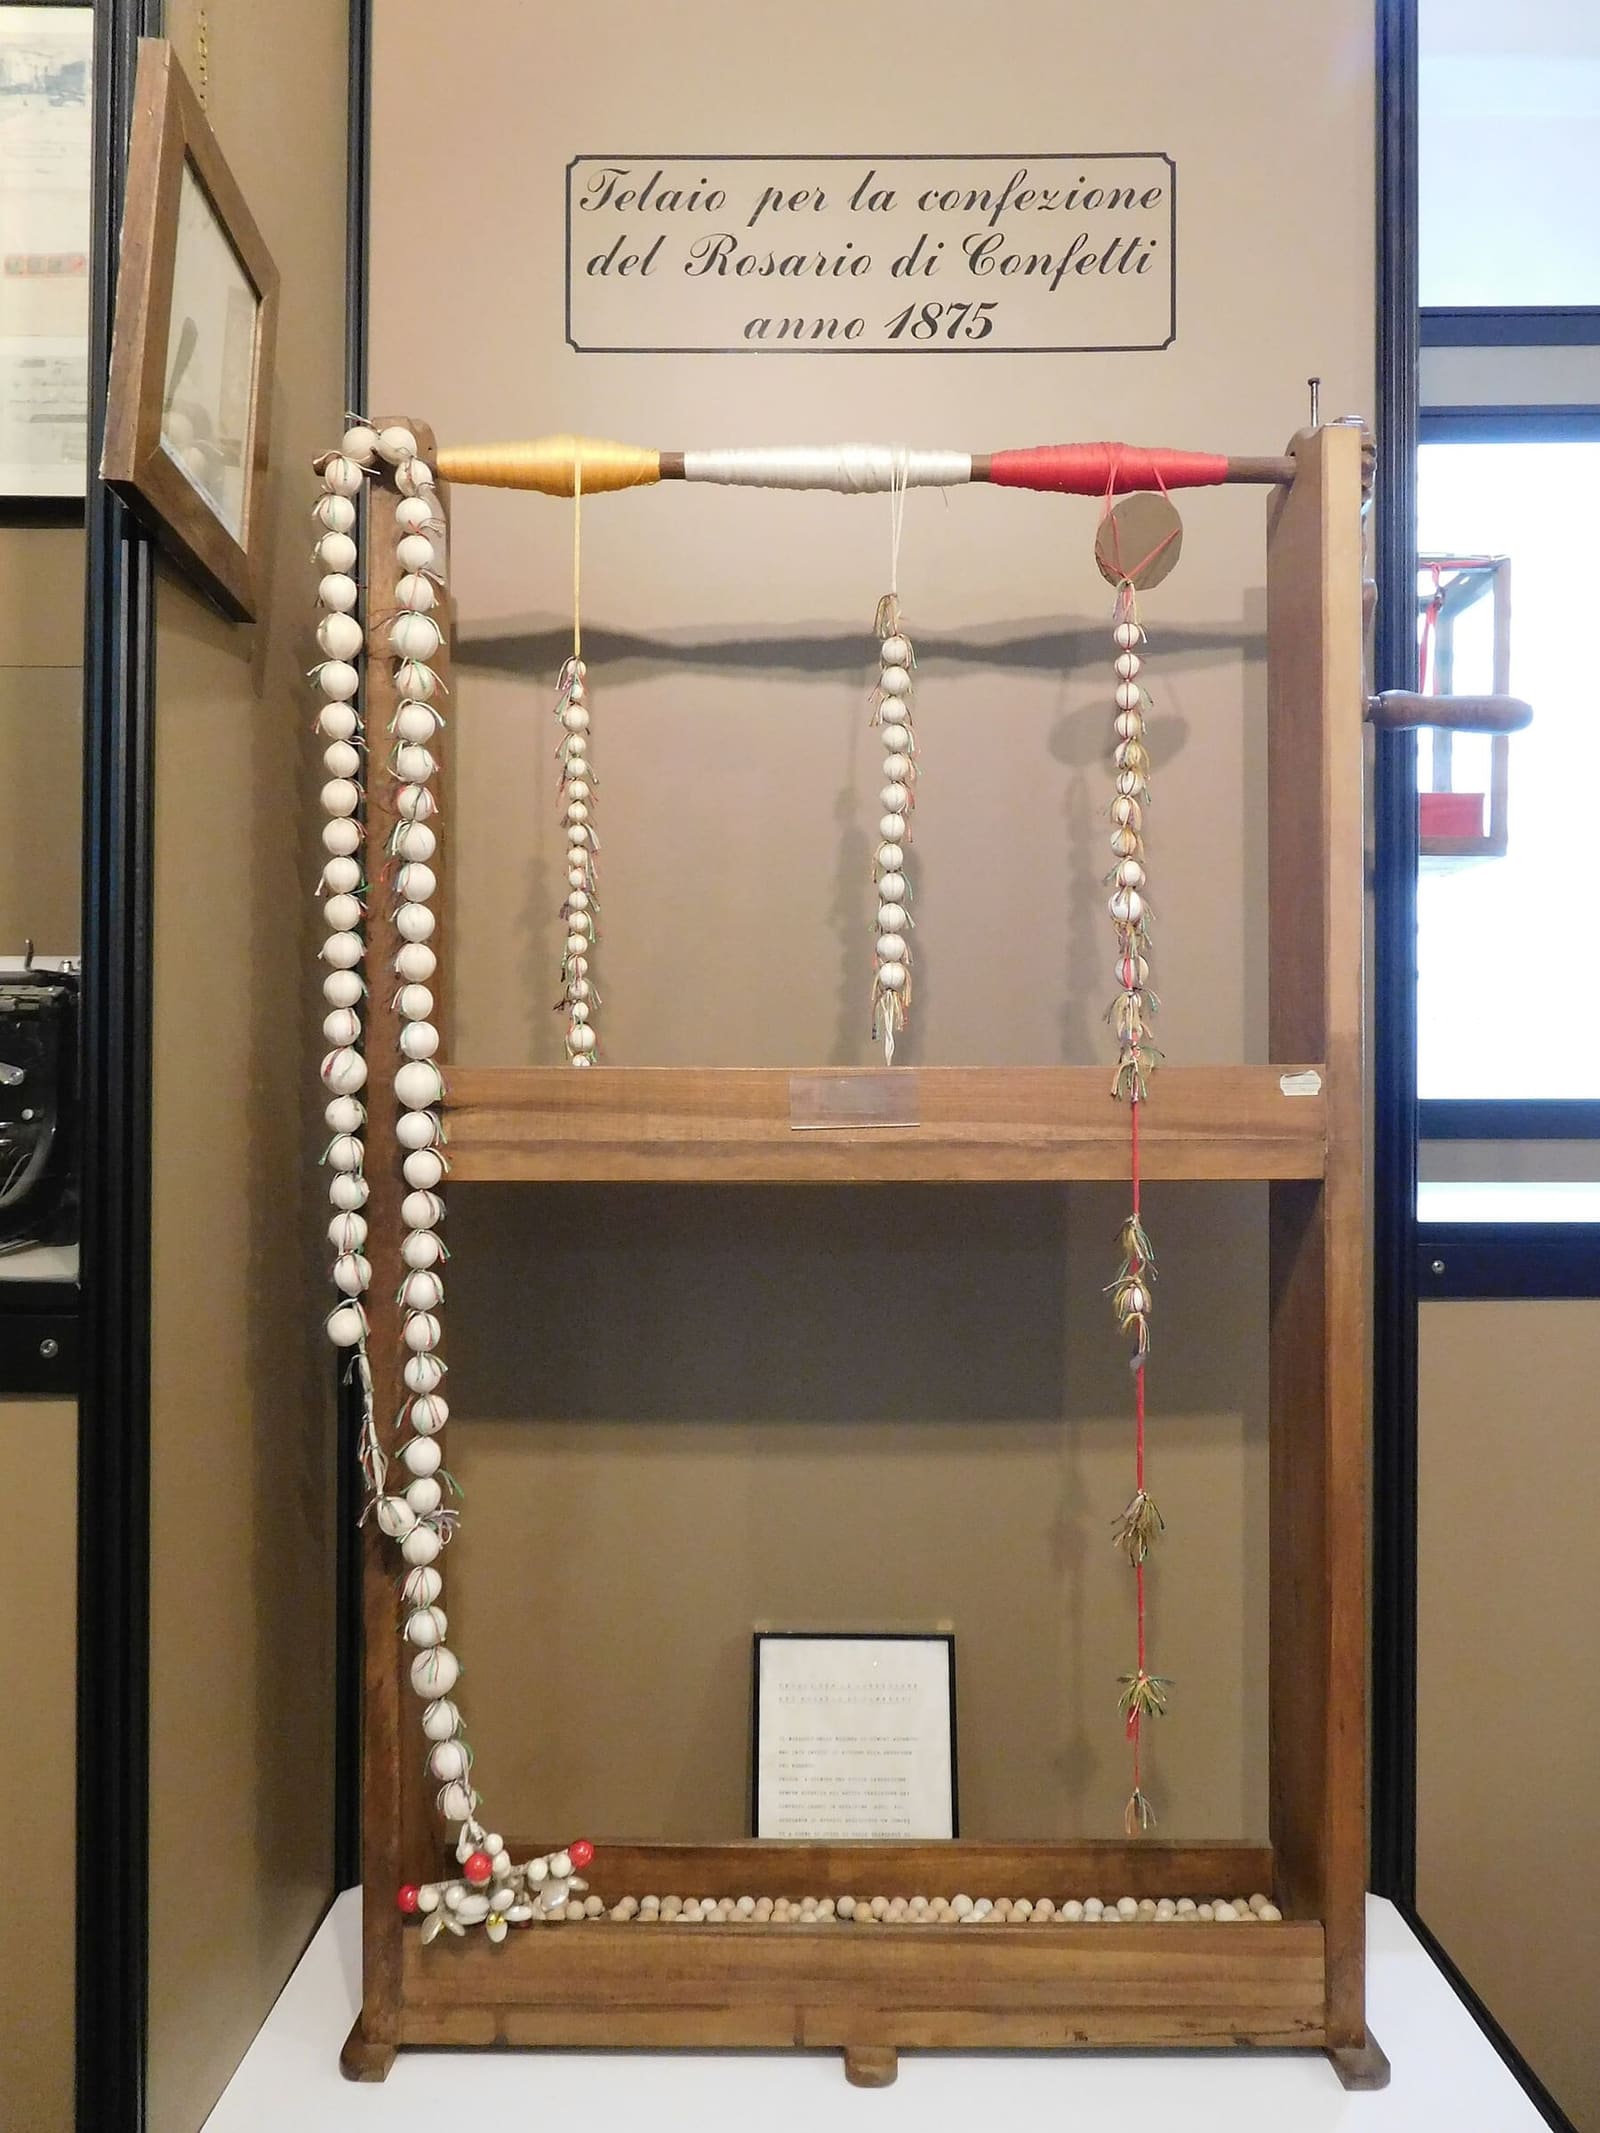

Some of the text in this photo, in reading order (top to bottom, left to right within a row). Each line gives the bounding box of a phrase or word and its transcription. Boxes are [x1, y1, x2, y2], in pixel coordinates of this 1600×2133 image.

[580, 167, 1163, 228] Telaio per la confezione
[586, 232, 1160, 292] del Rosario di Confetti
[743, 301, 1000, 341] anno 1875
